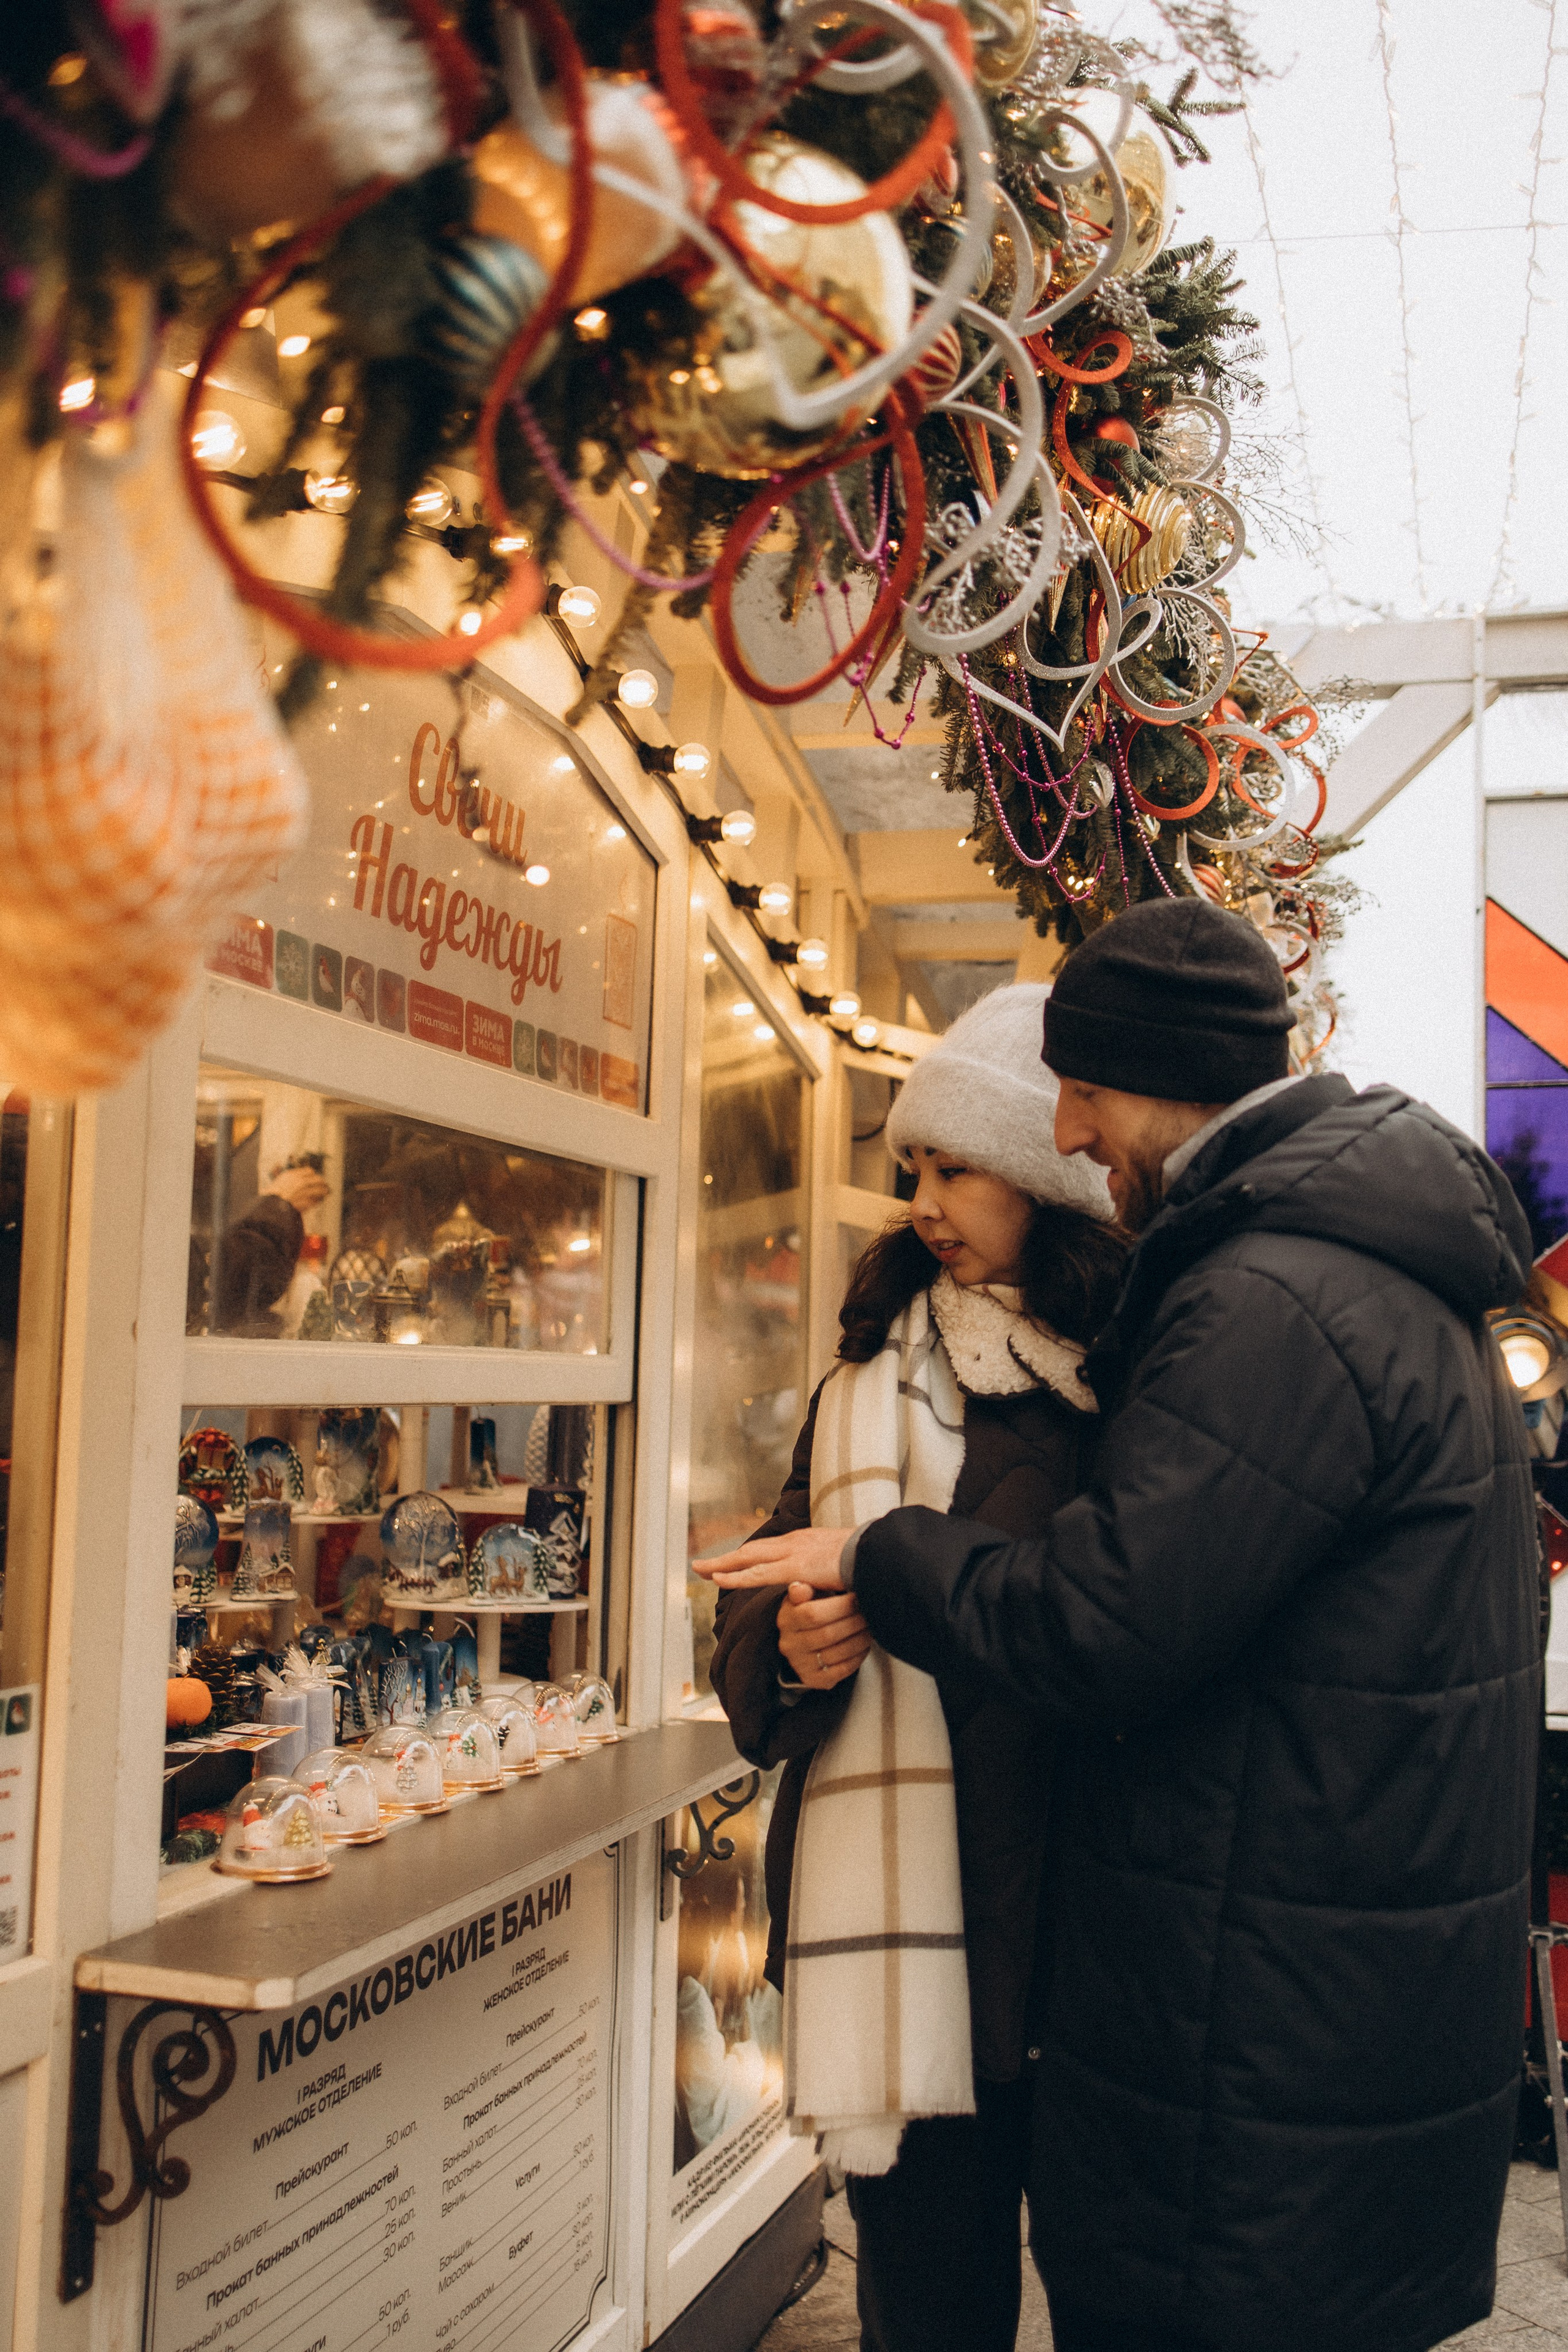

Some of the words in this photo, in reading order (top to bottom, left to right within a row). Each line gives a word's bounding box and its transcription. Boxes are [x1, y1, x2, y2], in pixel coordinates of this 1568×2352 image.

[409, 722, 528, 866] Свечи
[350, 815, 563, 1005] Надежды
[414, 1011, 458, 1034] zima.mos.ru
[472, 1014, 505, 1043] ЗИМА
[257, 1911, 496, 2082] МОСКОВСКИЕ
[501, 1873, 572, 1947] БАНИ
[516, 1947, 545, 1975] РАЗРЯД
[483, 1977, 524, 2013] ЖЕНСКОЕ
[525, 1950, 570, 1986] ОТДЕЛЕНИЕ
[506, 2007, 555, 2047] Прейскурант
[303, 2063, 346, 2101] РАЗРЯД
[444, 2076, 478, 2111] Входной
[480, 2062, 502, 2086] билет
[463, 2101, 492, 2130] Прокат
[494, 2079, 523, 2107] банных
[524, 2030, 587, 2086] принадлежностей
[253, 2102, 316, 2153] МУЖСКОЕ
[318, 2062, 382, 2113] ОТДЕЛЕНИЕ
[442, 2138, 473, 2173] Банный
[474, 2125, 497, 2150] халат
[275, 2142, 349, 2200] Прейскурант
[442, 2158, 482, 2196] Простынь
[515, 2163, 540, 2190] Услуги
[176, 2242, 230, 2291] Входной
[233, 2220, 268, 2252] билет
[386, 2130, 398, 2149] 50
[400, 2120, 418, 2140] коп.
[385, 2218, 397, 2239] 25
[398, 2207, 416, 2228] коп.
[442, 2190, 467, 2218] Веник
[206, 2267, 254, 2312] Прокат
[255, 2236, 300, 2276] банных
[302, 2163, 398, 2245] принадлежностей
[383, 2242, 396, 2263] 30
[398, 2231, 415, 2252] коп.
[439, 2237, 472, 2272] Банщик
[508, 2231, 533, 2260] Буфет
[224, 2297, 259, 2333] халат
[385, 2195, 397, 2216] 70
[398, 2185, 416, 2205] коп.
[438, 2256, 473, 2294] Массаж
[379, 2301, 391, 2321] 50
[393, 2288, 411, 2310] коп.
[386, 2323, 391, 2337] 1
[391, 2308, 410, 2337] руб.
[435, 2317, 451, 2339] Чай
[453, 2315, 459, 2326] с
[460, 2283, 495, 2321] сахаром
